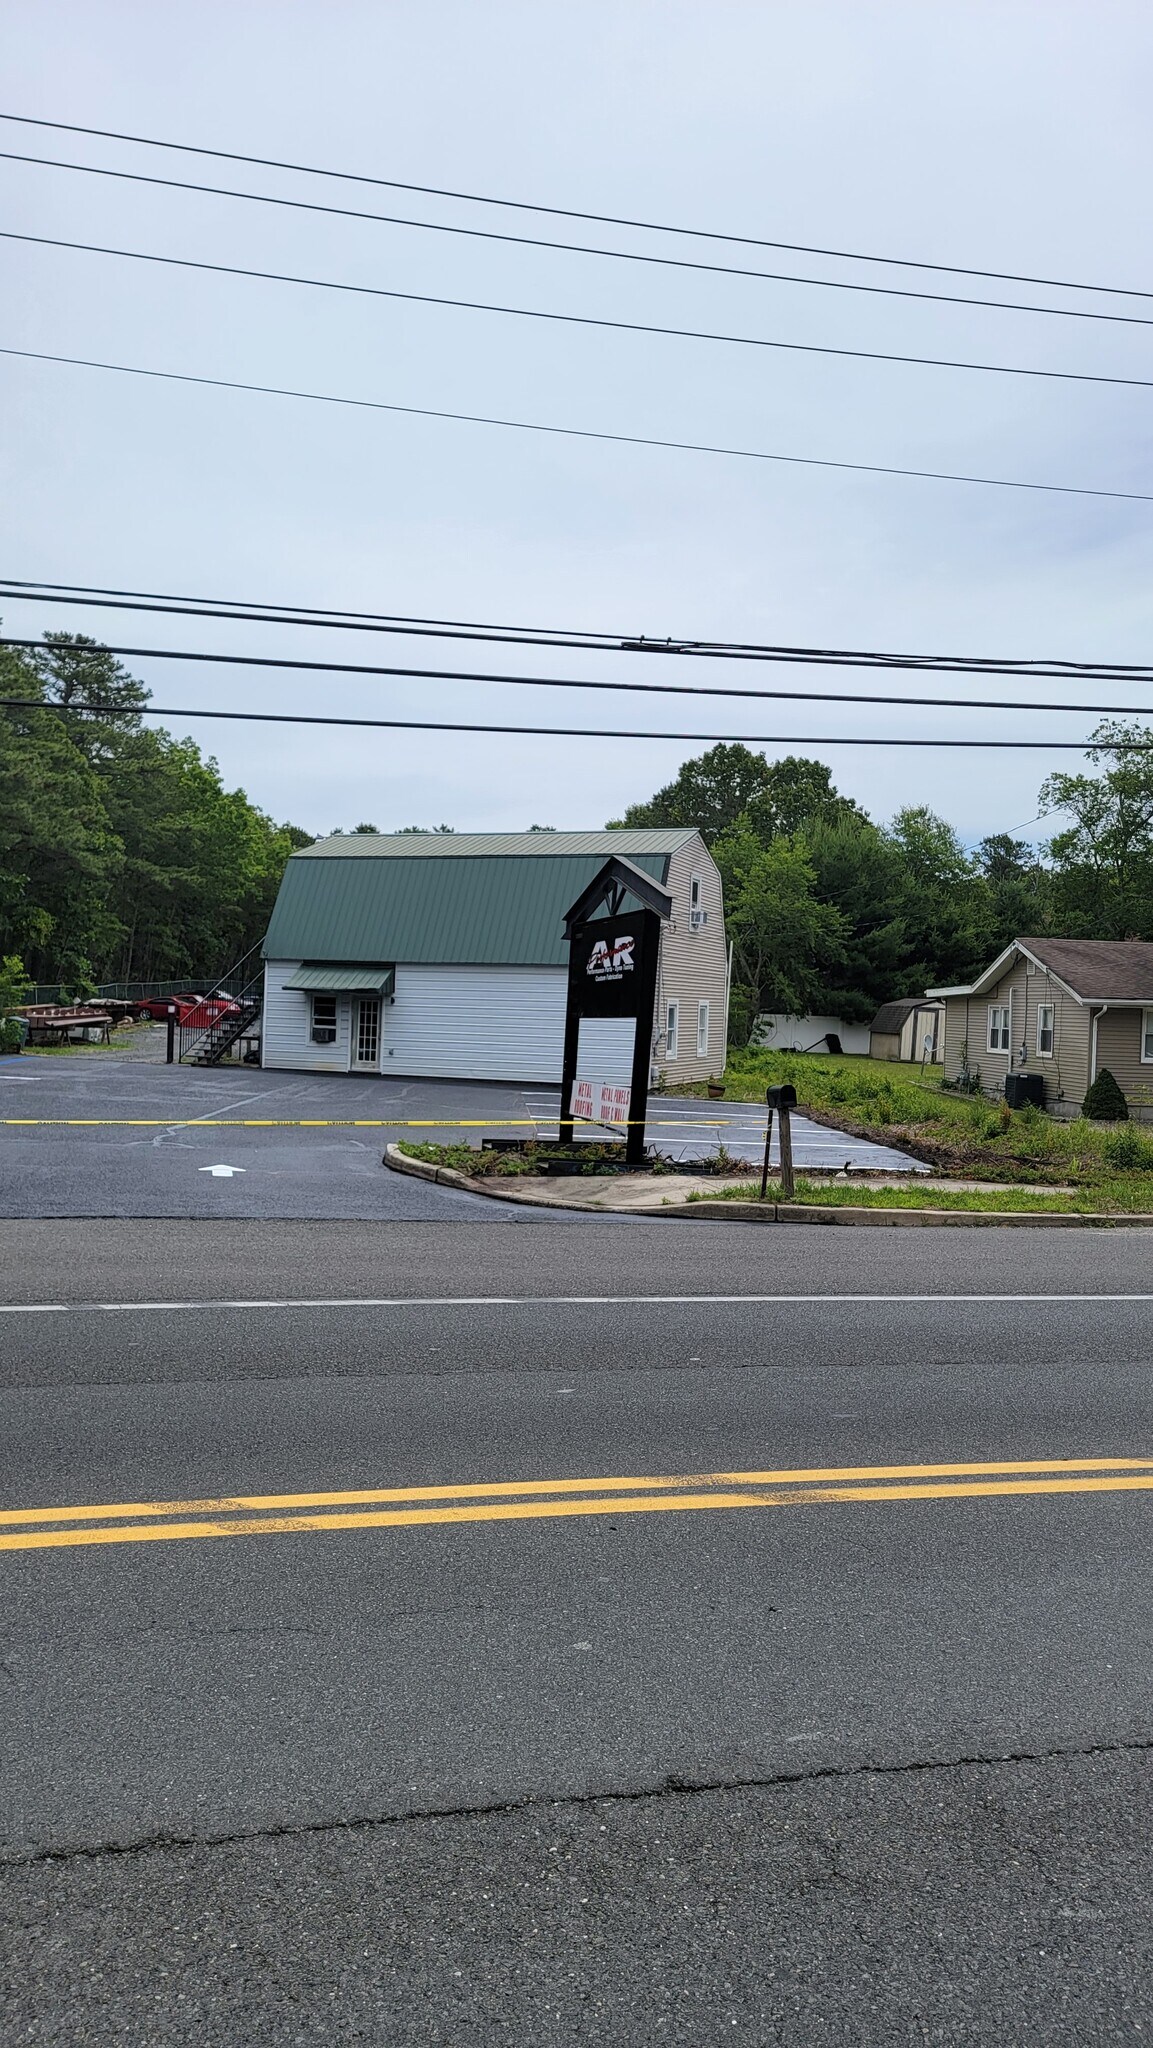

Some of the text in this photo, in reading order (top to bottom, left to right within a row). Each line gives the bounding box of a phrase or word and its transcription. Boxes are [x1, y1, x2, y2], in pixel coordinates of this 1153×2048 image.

[578, 1082, 592, 1098] METAL
[602, 1087, 630, 1105] METAL PANELS
[574, 1098, 592, 1116] ROOFING
[600, 1105, 610, 1120] ROOF
[614, 1108, 625, 1122] WALL
